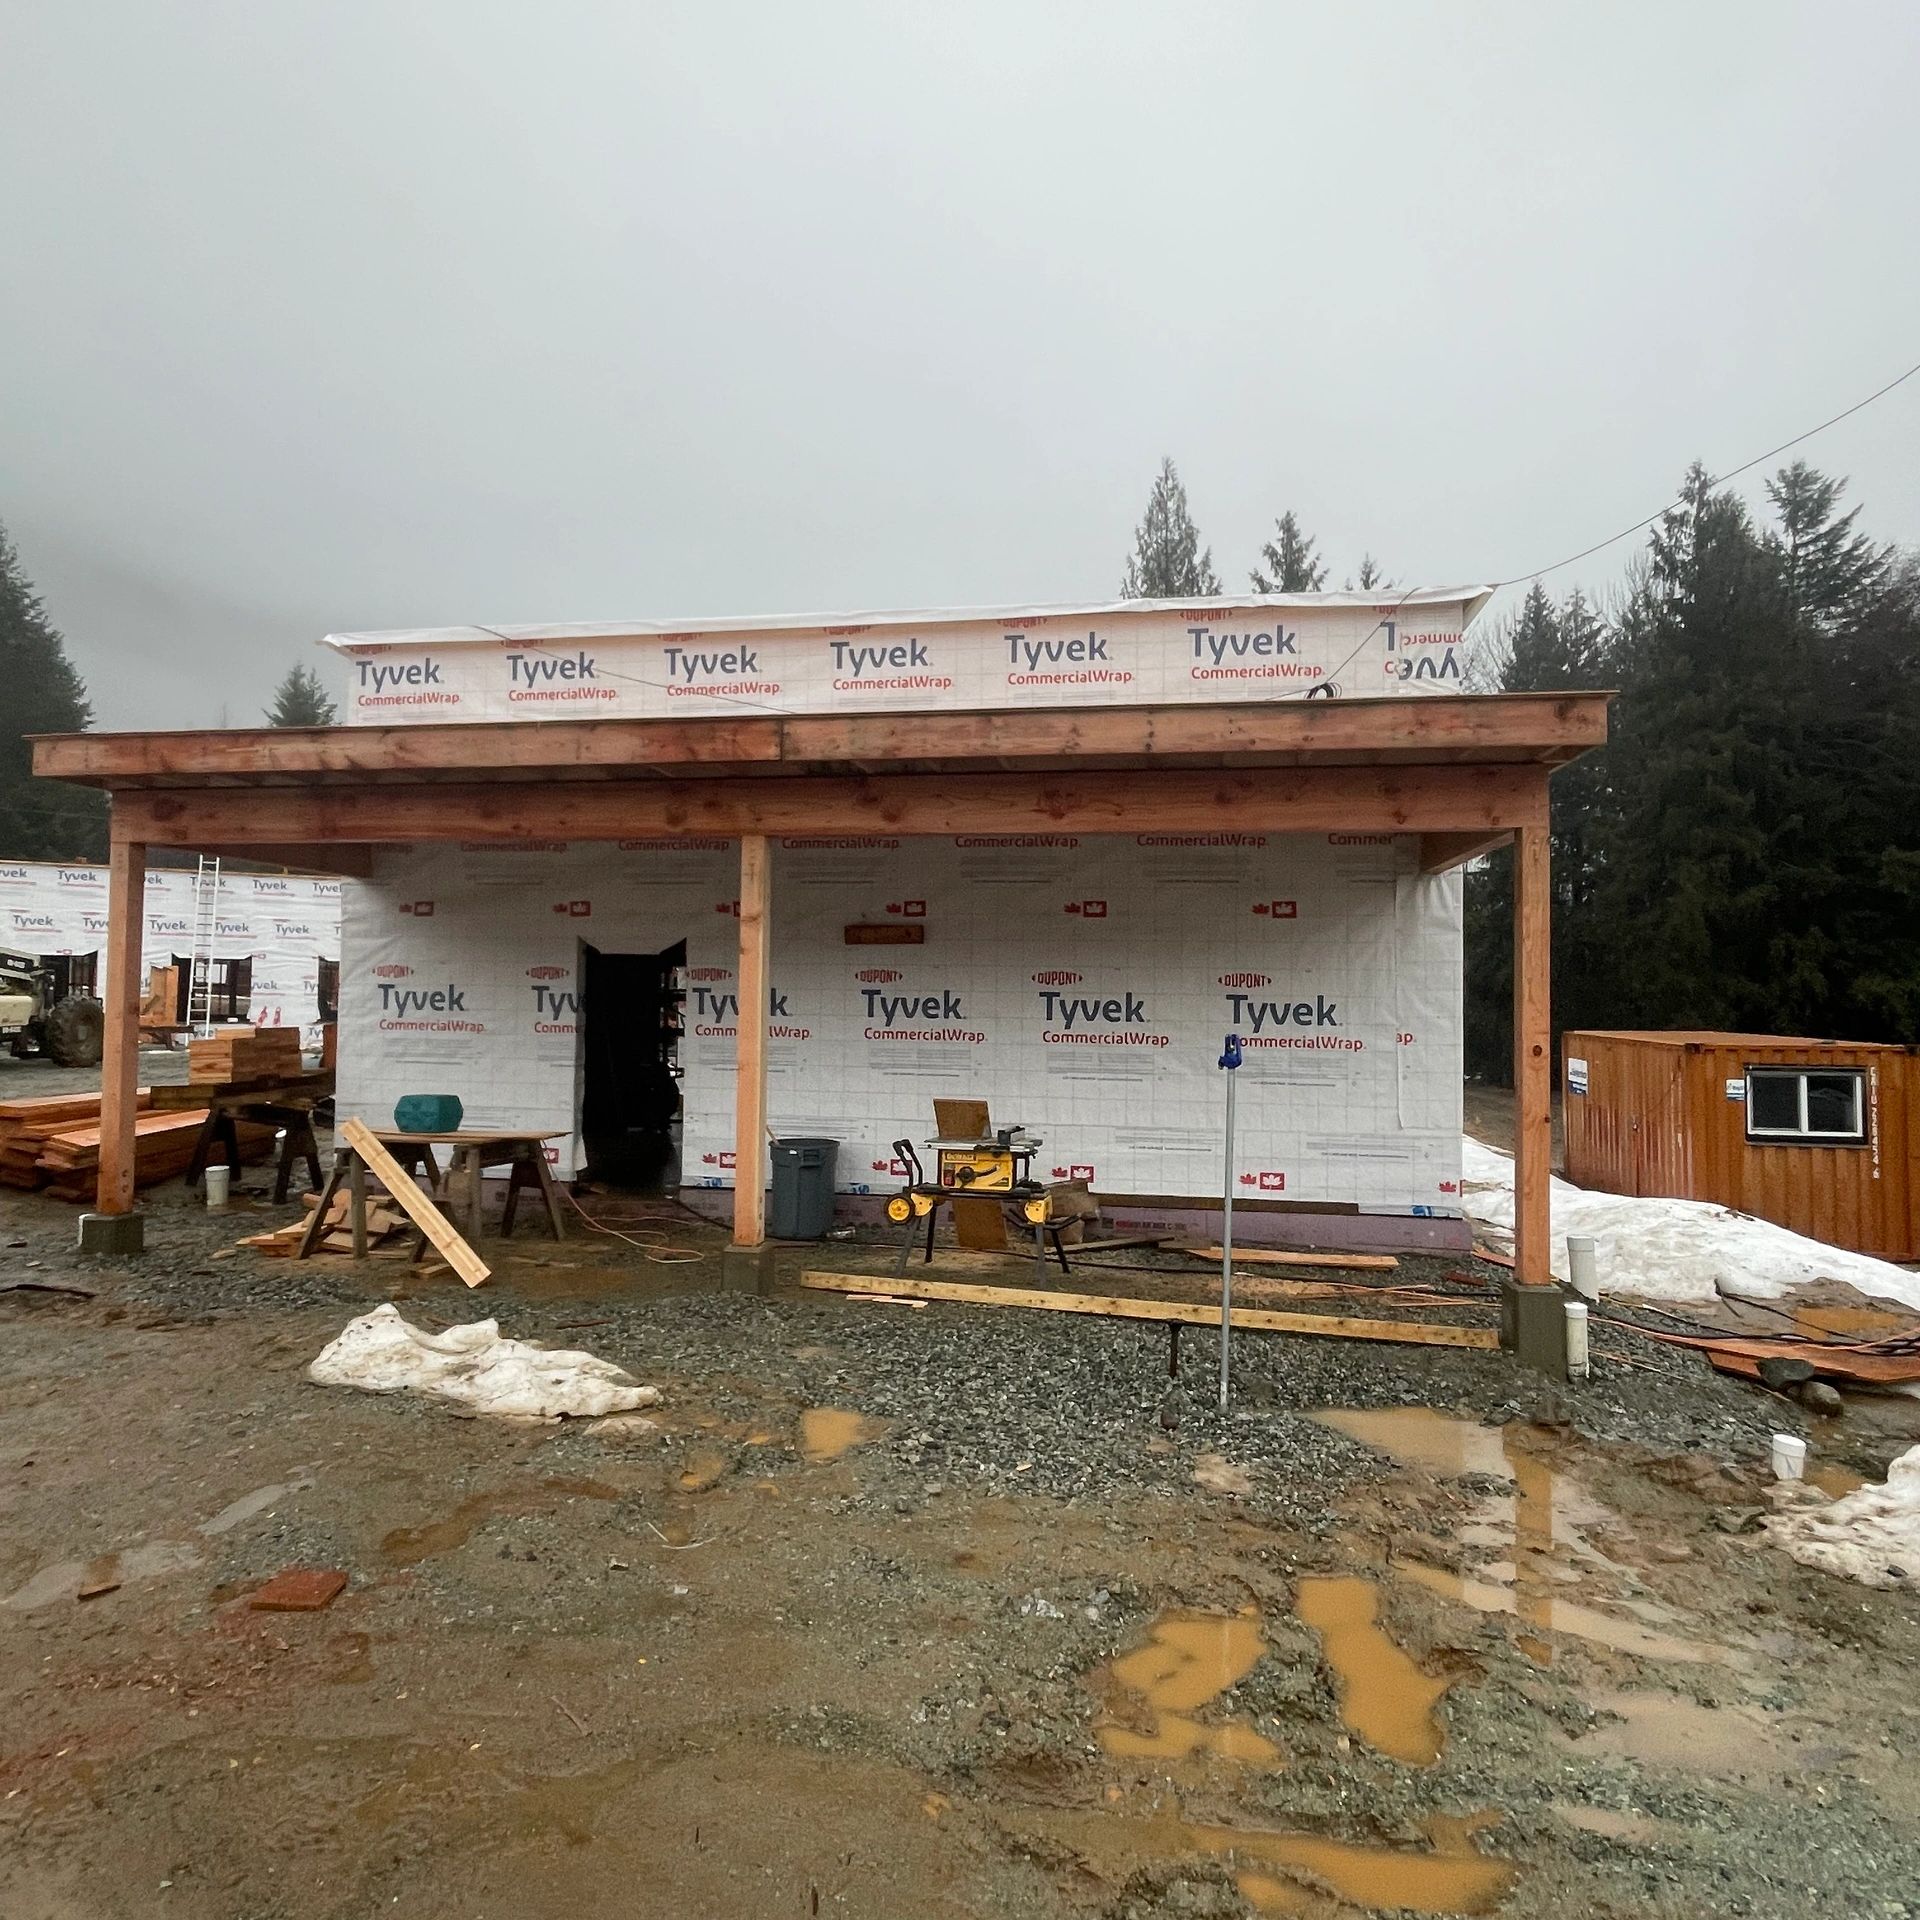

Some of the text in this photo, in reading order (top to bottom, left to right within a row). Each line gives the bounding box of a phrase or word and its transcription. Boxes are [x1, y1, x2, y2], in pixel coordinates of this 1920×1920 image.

[1004, 632, 1108, 671] Tyvek
[1187, 625, 1297, 665] Tyvek
[664, 645, 758, 683] Tyvek
[830, 638, 929, 677] Tyvek
[356, 658, 441, 693] Tyvek
[506, 652, 596, 688] Tyvek
[1191, 664, 1323, 680] CommercialWrap
[833, 675, 952, 691] CommercialWrap
[1007, 671, 1133, 686] CommercialWrap
[508, 687, 617, 702] CommercialWrap
[666, 682, 780, 697] CommercialWrap
[358, 692, 460, 707] CommercialWrap
[782, 837, 900, 850] CommercialWrap
[955, 835, 1079, 849] CommercialWrap
[1136, 834, 1267, 848] CommercialWrap
[57, 870, 97, 882] Tyvek
[253, 879, 287, 891] Tyvek
[13, 915, 53, 927] Tyvek
[149, 920, 187, 932] Tyvek
[275, 923, 310, 936] Tyvek
[690, 967, 728, 982] DUPONT
[860, 969, 899, 984] DUPONT
[1037, 971, 1078, 986] DUPONT
[1224, 973, 1267, 988] DUPONT
[377, 984, 465, 1018] Tyvek
[692, 988, 789, 1023] Tyk
[861, 990, 963, 1027] Tyvek
[1039, 992, 1145, 1030] Tyvek
[1226, 994, 1338, 1034] Tyvek
[379, 1018, 485, 1035] CommercialWrap
[864, 1027, 985, 1043] CommercialWrap
[1042, 1030, 1170, 1049] CommercialWrap
[1239, 1035, 1364, 1052] ommercialWrap
